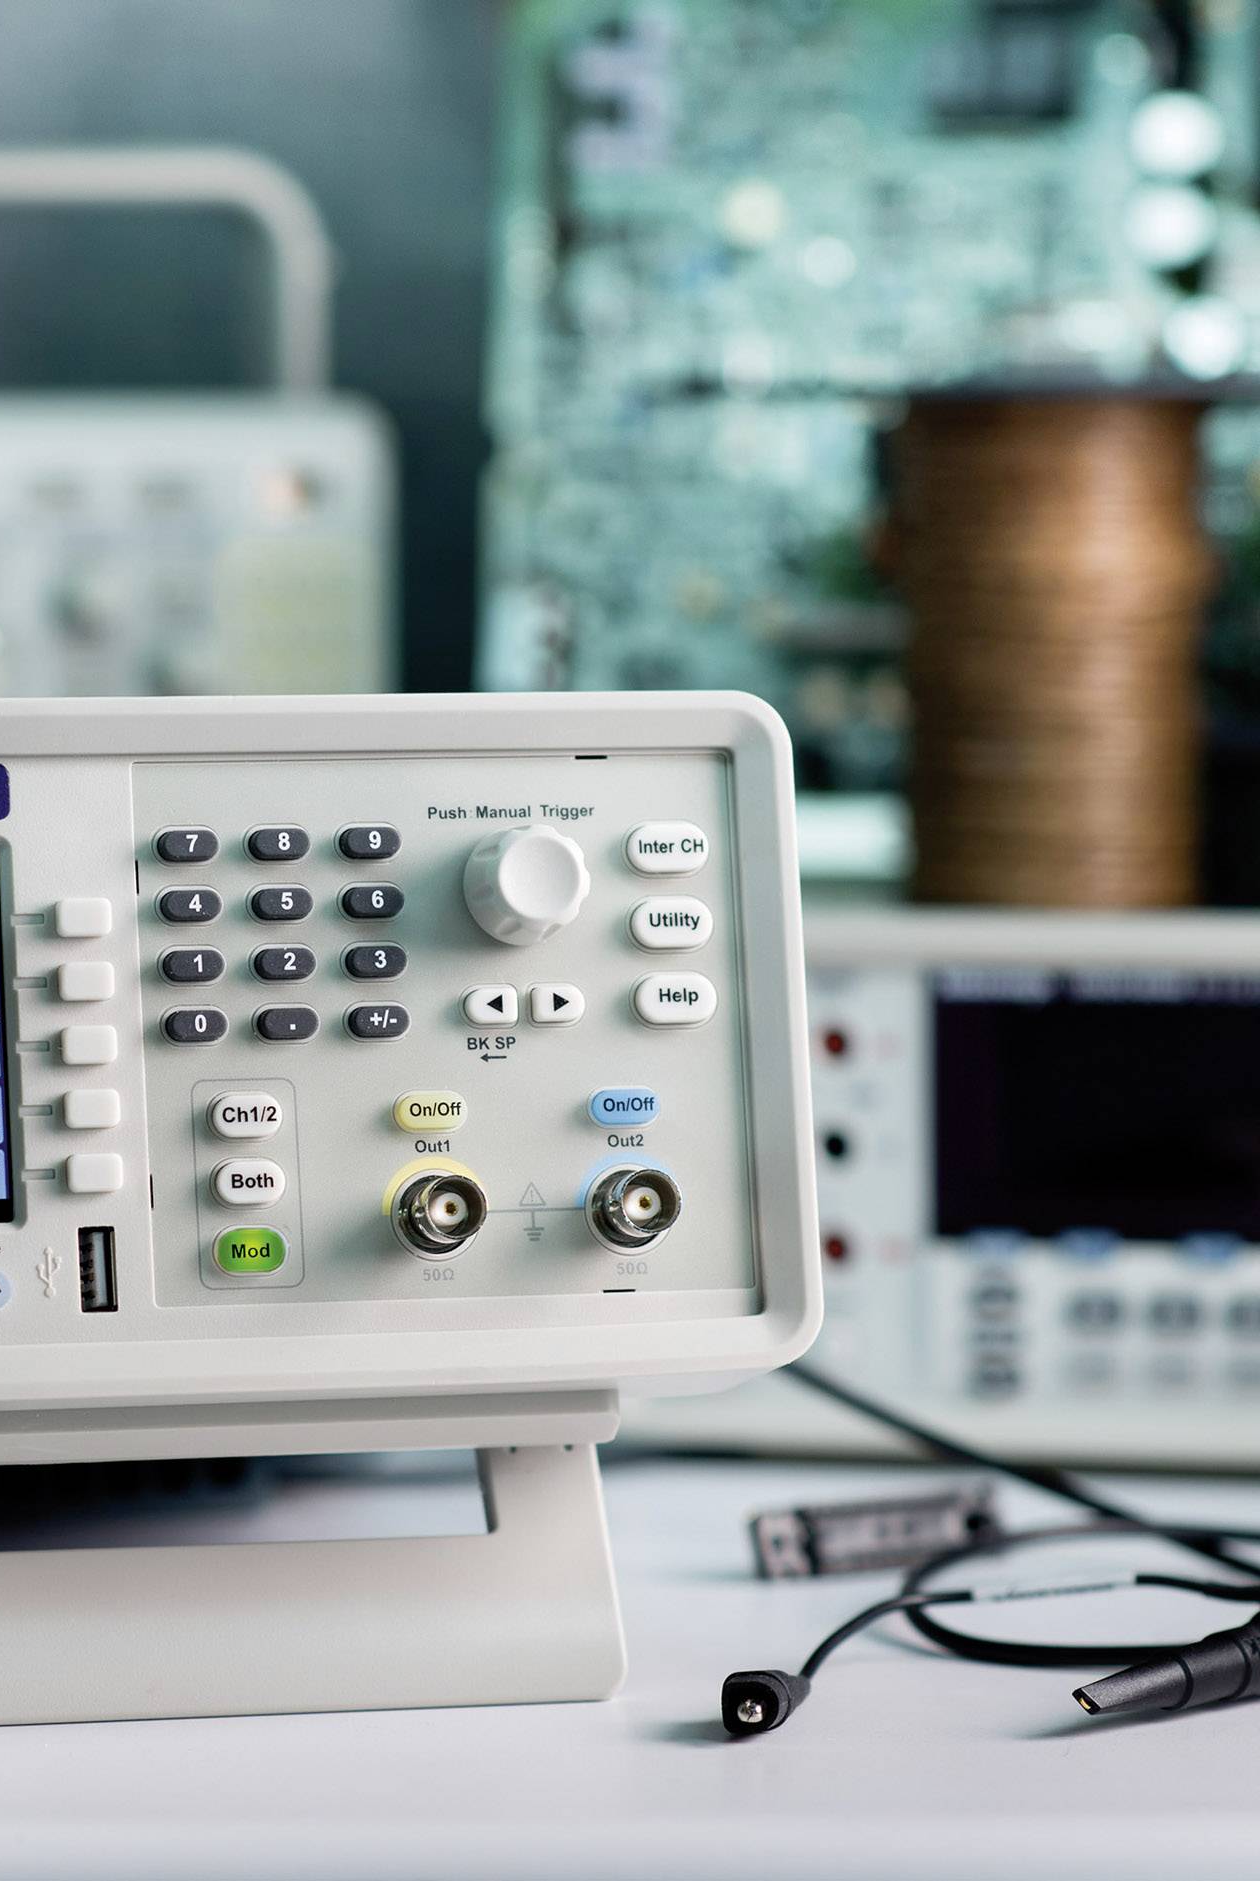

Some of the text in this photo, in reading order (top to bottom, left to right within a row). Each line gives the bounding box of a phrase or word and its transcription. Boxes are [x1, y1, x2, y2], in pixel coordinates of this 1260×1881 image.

[427, 804, 595, 820] Push Manual Trigger
[186, 834, 199, 852] 7
[278, 832, 291, 850] 8
[368, 831, 382, 849] 9
[639, 838, 704, 853] Inter CH
[188, 894, 202, 912] 4
[281, 892, 294, 910] 5
[371, 891, 384, 909] 6
[649, 913, 700, 930] Utility
[194, 955, 204, 972] 1
[284, 952, 297, 970] 2
[374, 950, 388, 968] 3
[658, 987, 700, 1005] Help
[195, 1014, 207, 1033] 0
[370, 1009, 398, 1028] +/-
[467, 1036, 516, 1049] BK SP
[409, 1102, 462, 1117] On/Off
[602, 1097, 655, 1112] On/Off
[222, 1105, 278, 1124] Ch1/2
[414, 1139, 451, 1152] Out1
[607, 1134, 644, 1147] Out2
[230, 1172, 274, 1188] Both
[231, 1242, 271, 1259] Mod
[423, 1267, 454, 1281] 50Ω
[616, 1262, 648, 1275] 50Ω
